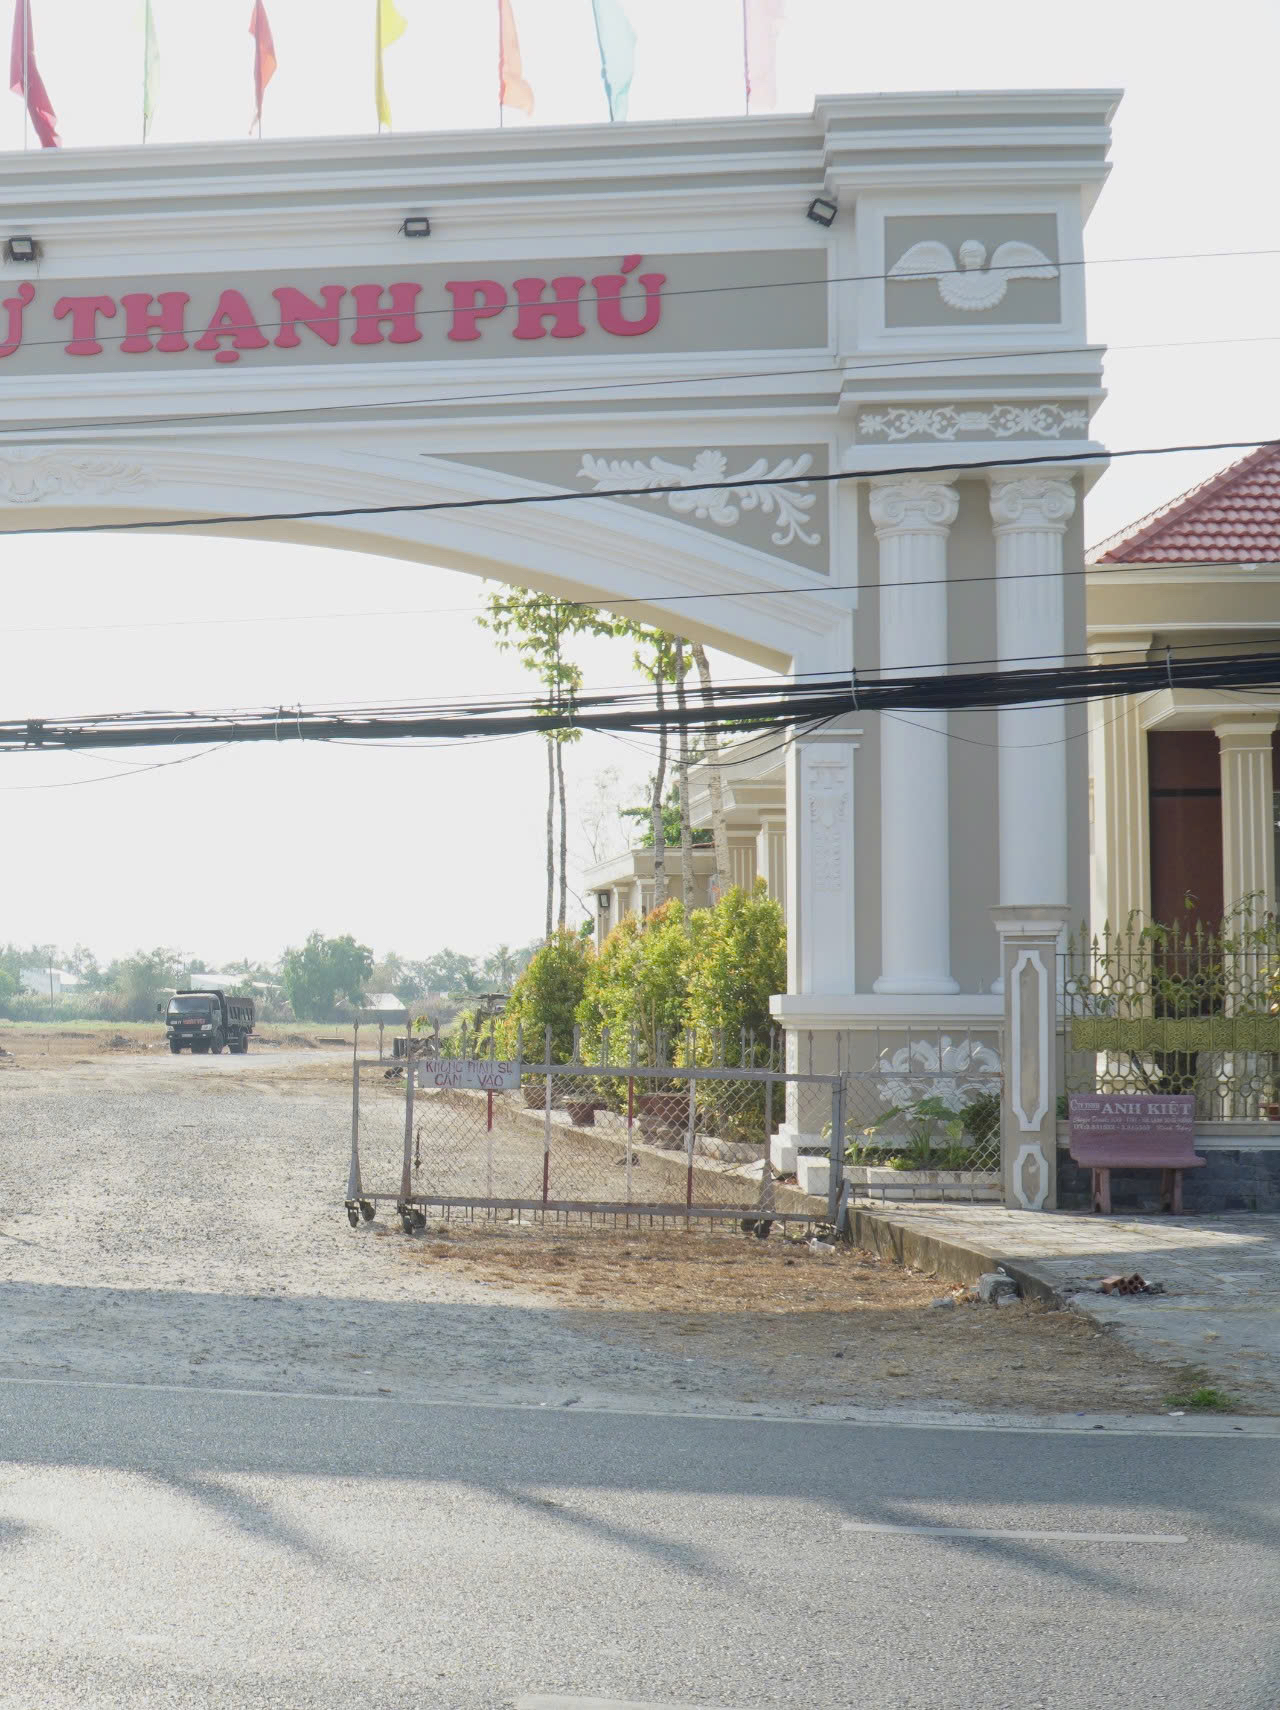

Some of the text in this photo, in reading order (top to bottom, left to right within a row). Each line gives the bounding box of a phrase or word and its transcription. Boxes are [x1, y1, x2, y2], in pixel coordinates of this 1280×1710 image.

[53, 283, 422, 364] THẠNH
[445, 253, 667, 342] PHÚ
[1101, 1102, 1142, 1115] ANH
